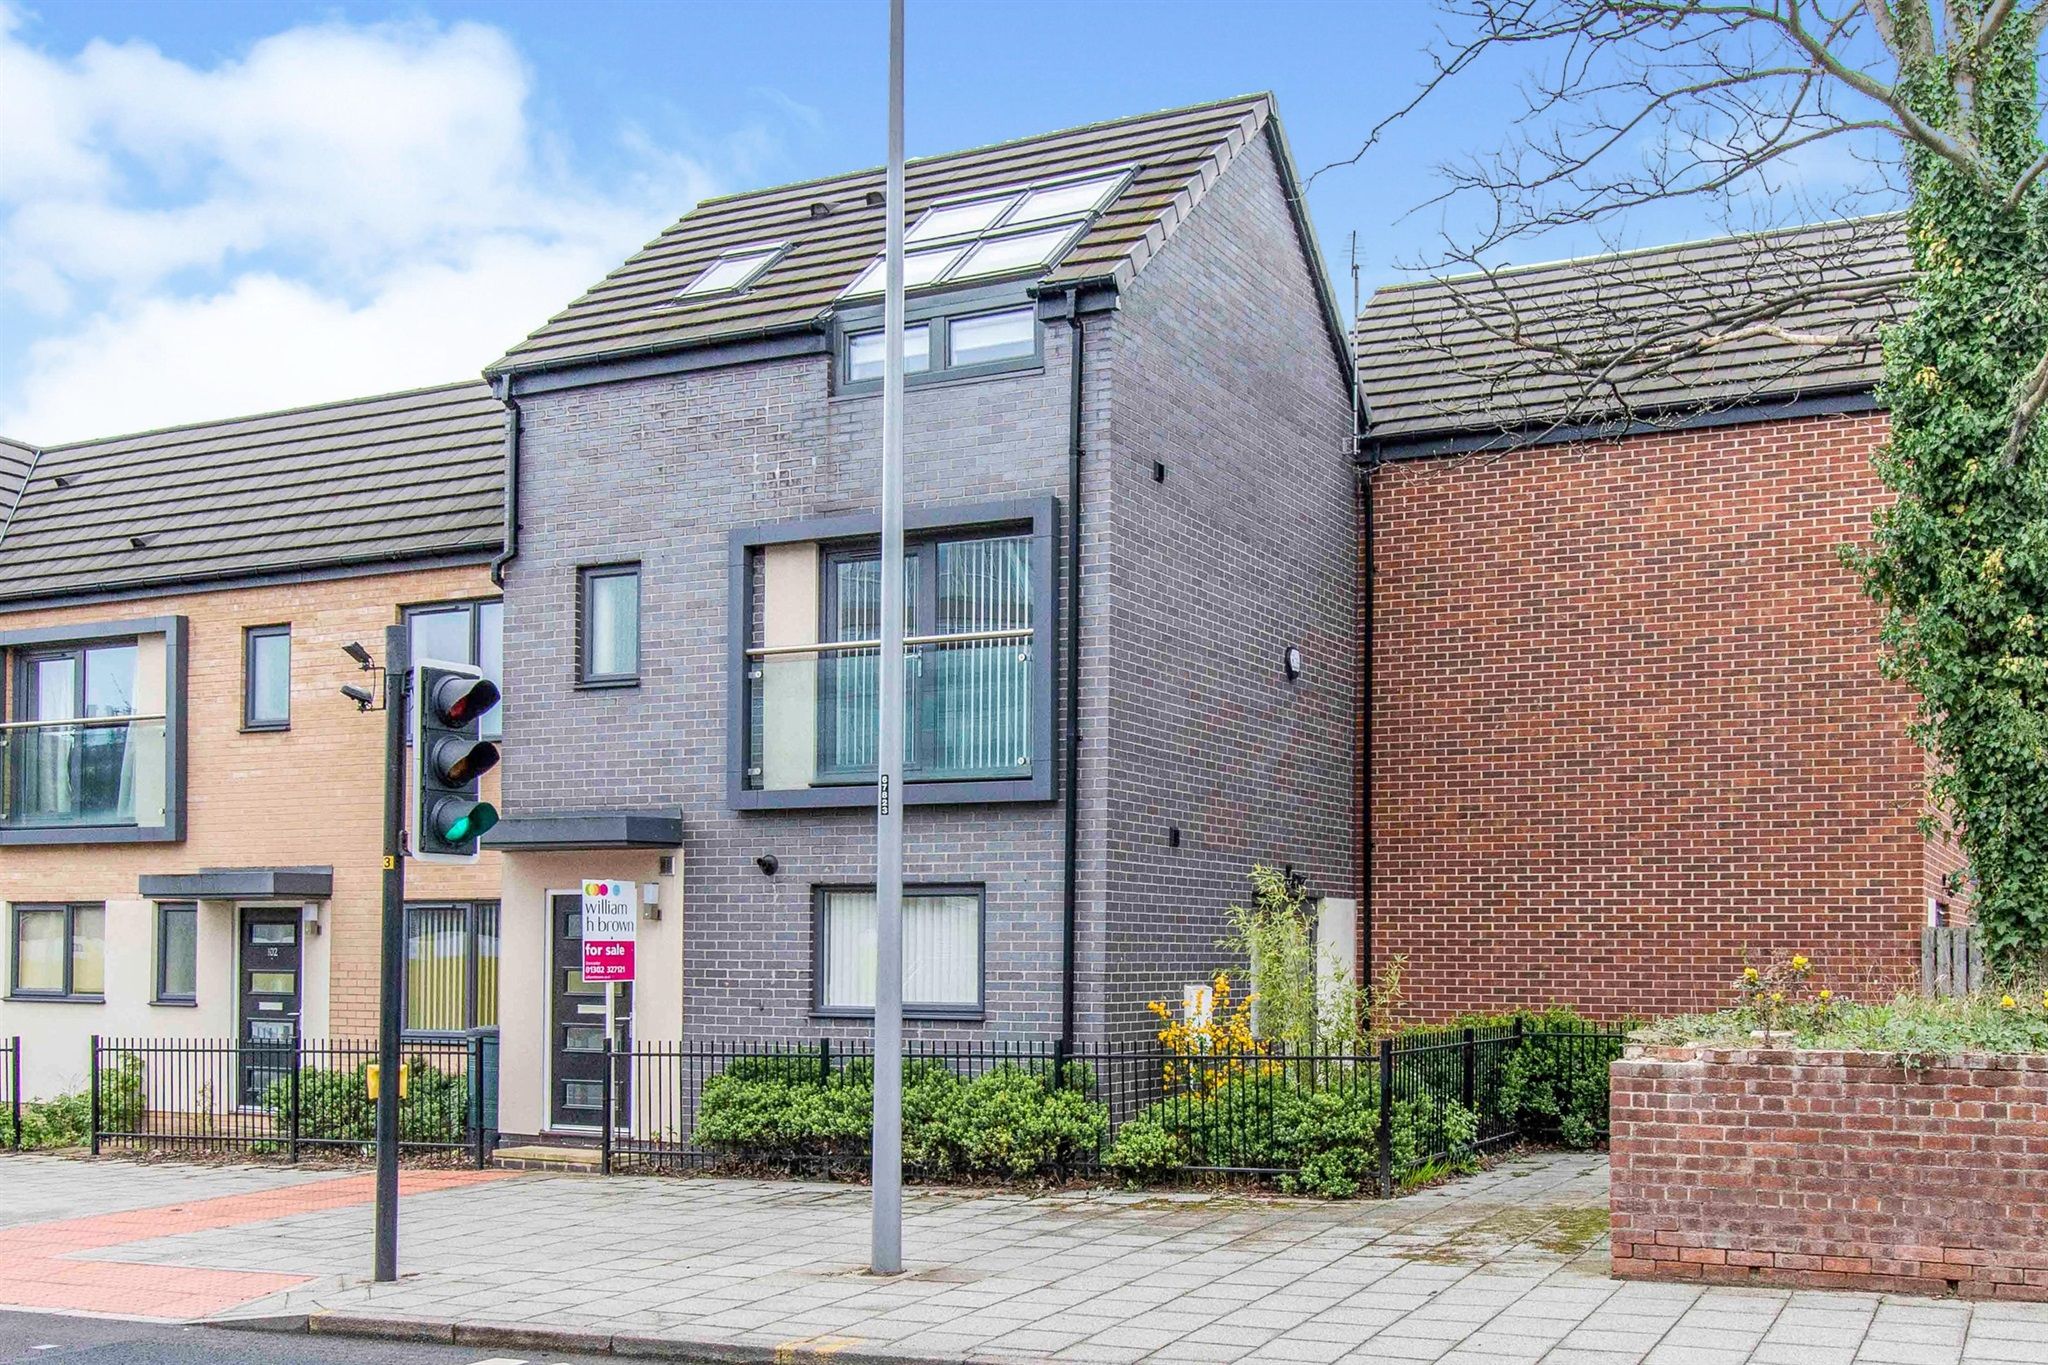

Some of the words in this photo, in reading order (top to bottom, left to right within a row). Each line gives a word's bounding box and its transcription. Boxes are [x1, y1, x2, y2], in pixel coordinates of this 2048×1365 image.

[384, 857, 391, 867] 3
[585, 899, 628, 915] william
[586, 916, 594, 932] h
[597, 916, 634, 932] brown
[585, 943, 603, 956] for
[605, 943, 625, 956] sale
[585, 965, 605, 974] 01302
[606, 965, 626, 974] 327121
